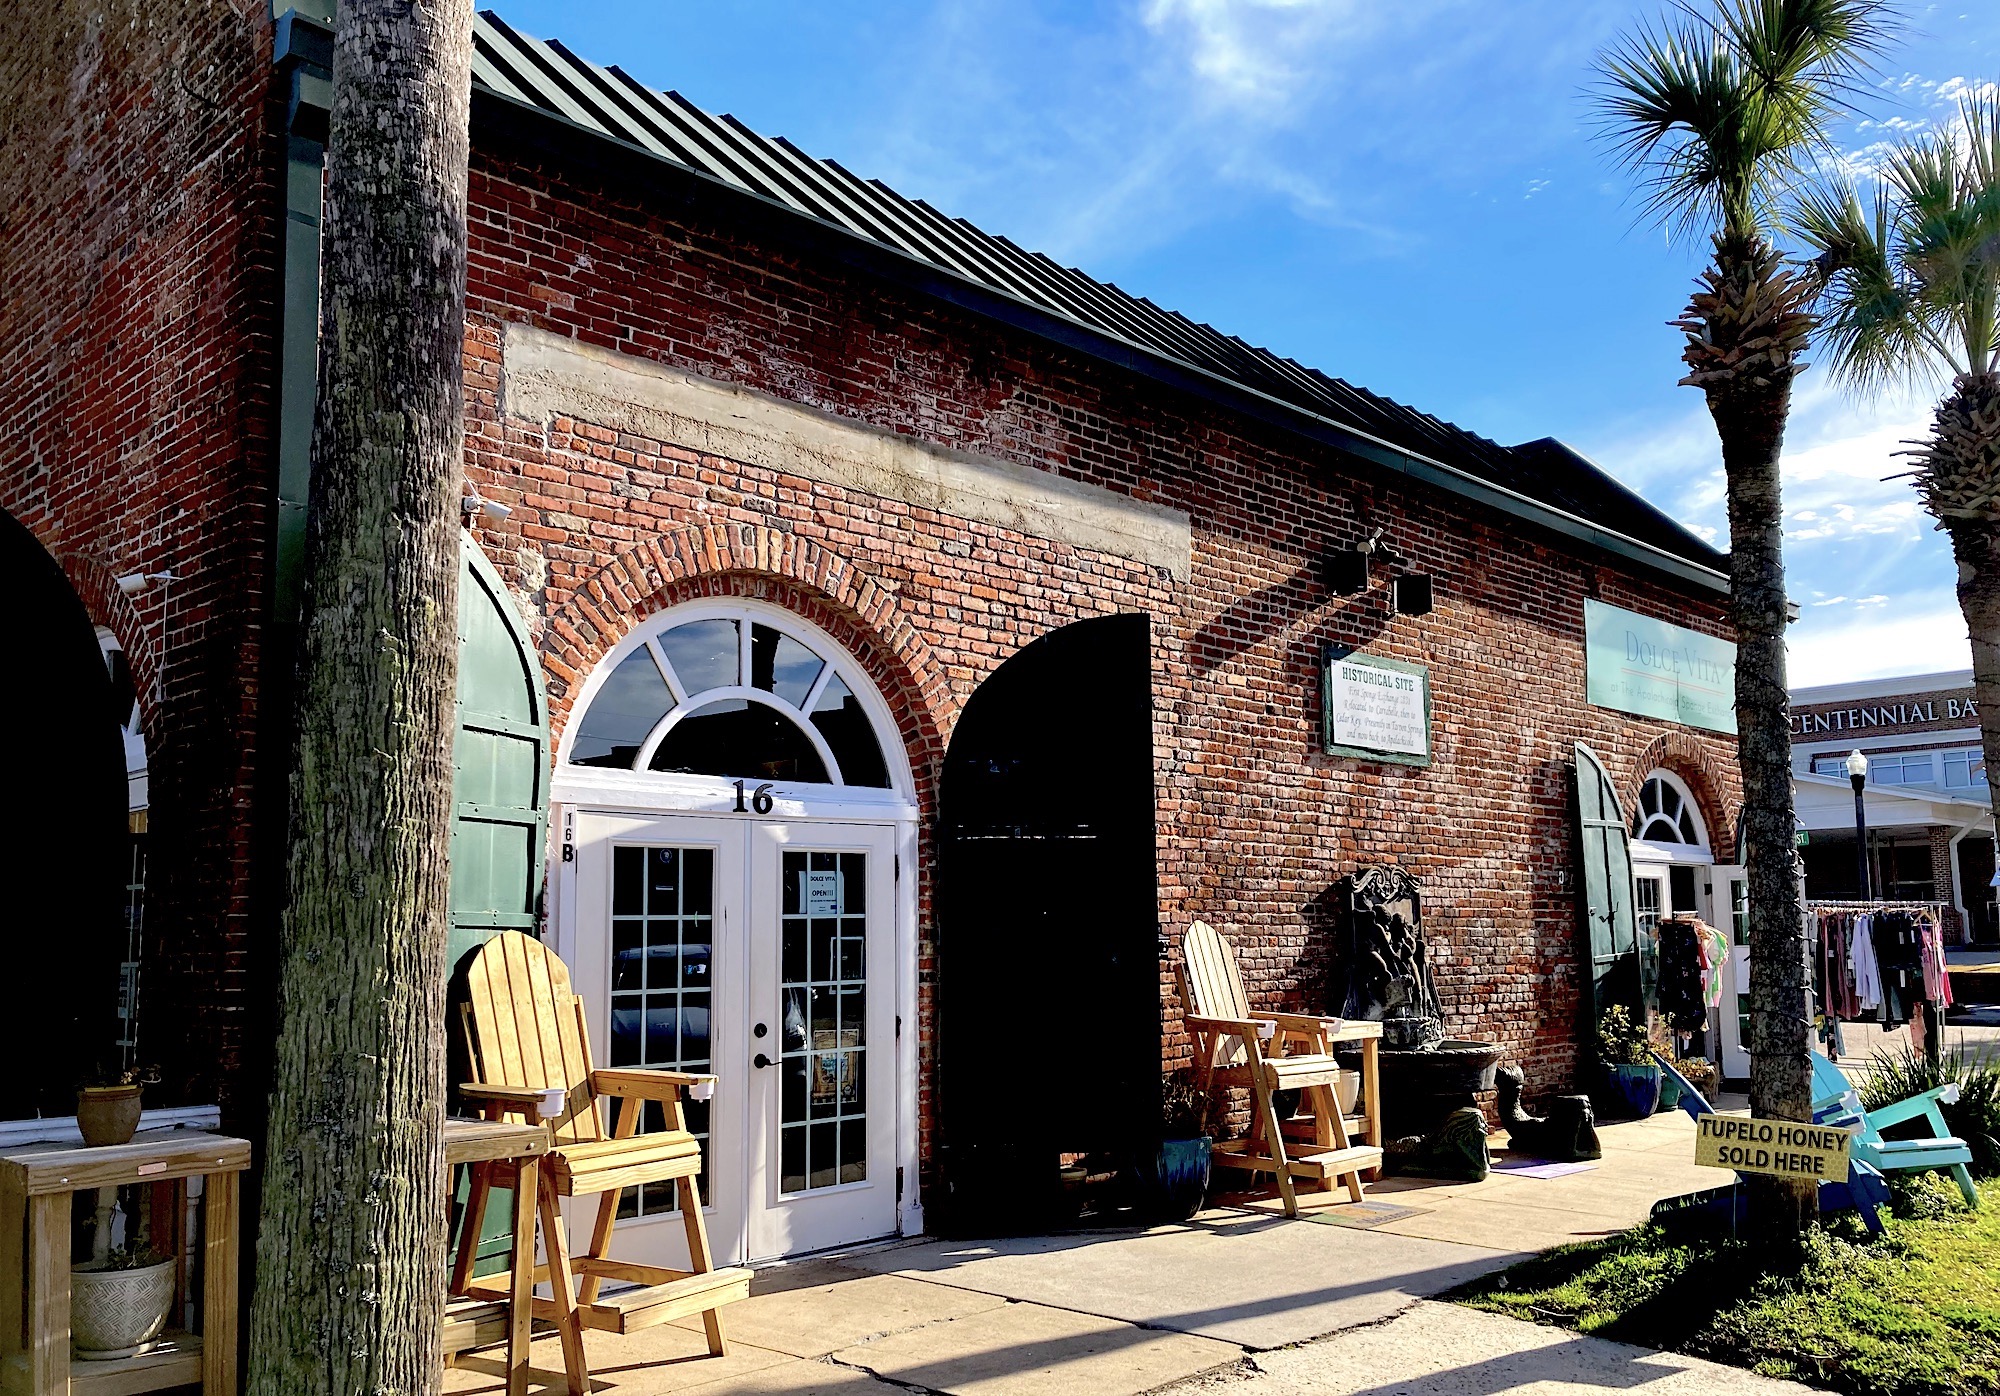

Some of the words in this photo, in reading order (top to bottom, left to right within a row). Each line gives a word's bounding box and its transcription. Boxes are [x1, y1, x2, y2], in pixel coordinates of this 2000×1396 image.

[1625, 630, 1681, 674] DOLCE
[1684, 648, 1721, 685] VITA
[1342, 666, 1393, 688] HISTORICAL
[1395, 677, 1414, 692] SITE
[1610, 683, 1619, 693] at
[1621, 681, 1634, 696] The
[1681, 695, 1706, 715] Sponge
[1789, 701, 1940, 735] CENTENNIAL
[1946, 697, 1979, 719] BA
[732, 779, 775, 815] 16
[1700, 1118, 1774, 1144] TUPELO
[1777, 1127, 1849, 1152] HONEY
[1718, 1145, 1770, 1168] SOLD
[1774, 1151, 1825, 1175] HERE
